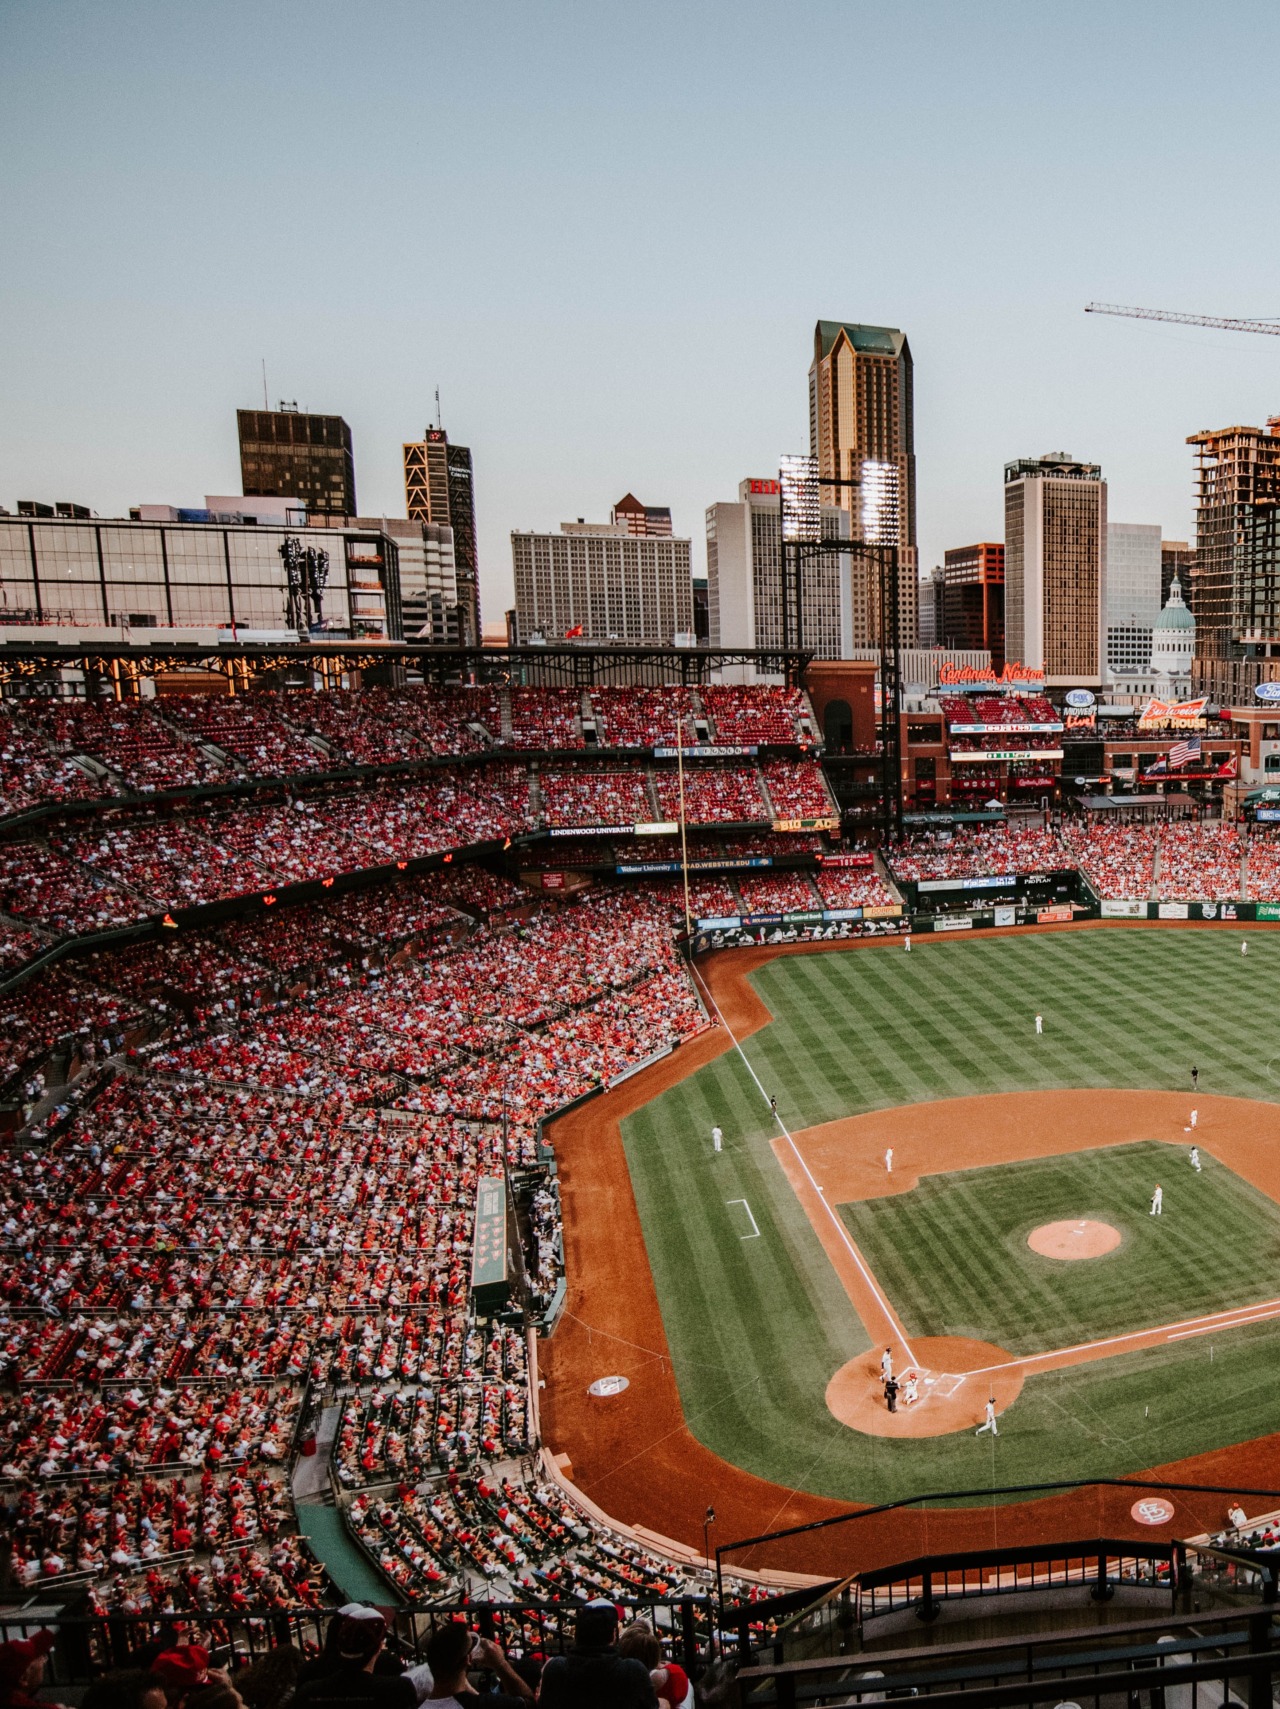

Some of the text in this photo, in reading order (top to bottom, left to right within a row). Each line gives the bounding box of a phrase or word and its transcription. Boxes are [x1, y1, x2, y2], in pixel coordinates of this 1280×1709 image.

[940, 661, 1044, 684] Cardinals Nation
[1063, 707, 1098, 716] MIDWEST
[1140, 704, 1205, 719] Budweiser
[1139, 718, 1206, 729] BREW HOUSE
[550, 826, 634, 836] LINDENWOOD UNIVERSITY
[780, 820, 801, 832] BIG
[644, 864, 670, 872] University
[790, 912, 822, 922] Central Bank
